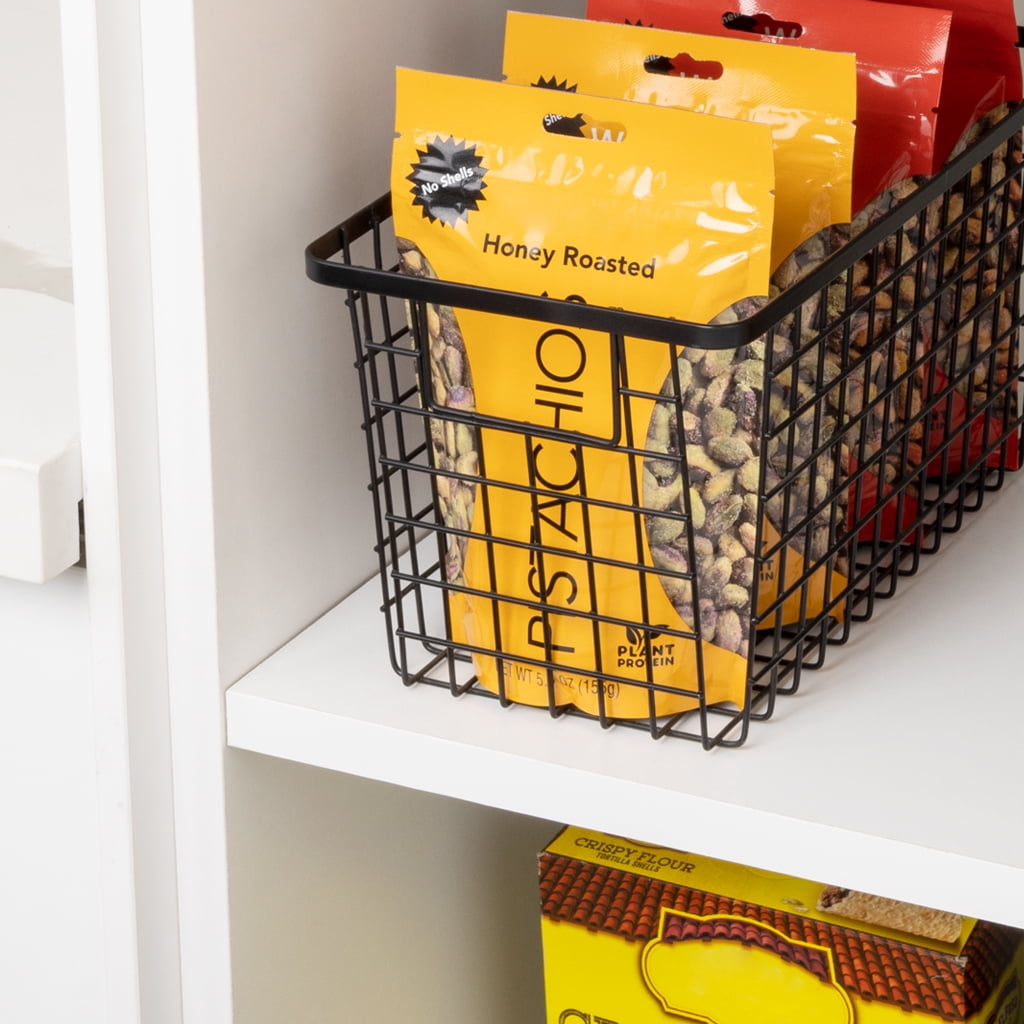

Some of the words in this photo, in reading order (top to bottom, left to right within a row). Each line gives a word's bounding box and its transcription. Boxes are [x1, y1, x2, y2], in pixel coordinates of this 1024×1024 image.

[420, 180, 439, 196] No
[440, 166, 474, 188] Shells
[482, 232, 556, 269] Honey
[563, 245, 657, 280] Roasted
[618, 644, 675, 658] PLANT
[618, 656, 674, 668] PROEIN
[516, 665, 533, 684] WT
[574, 837, 638, 858] CRISPY
[636, 852, 697, 874] FLOUR
[596, 852, 630, 866] TORTILLA
[631, 861, 662, 873] SHELLS
